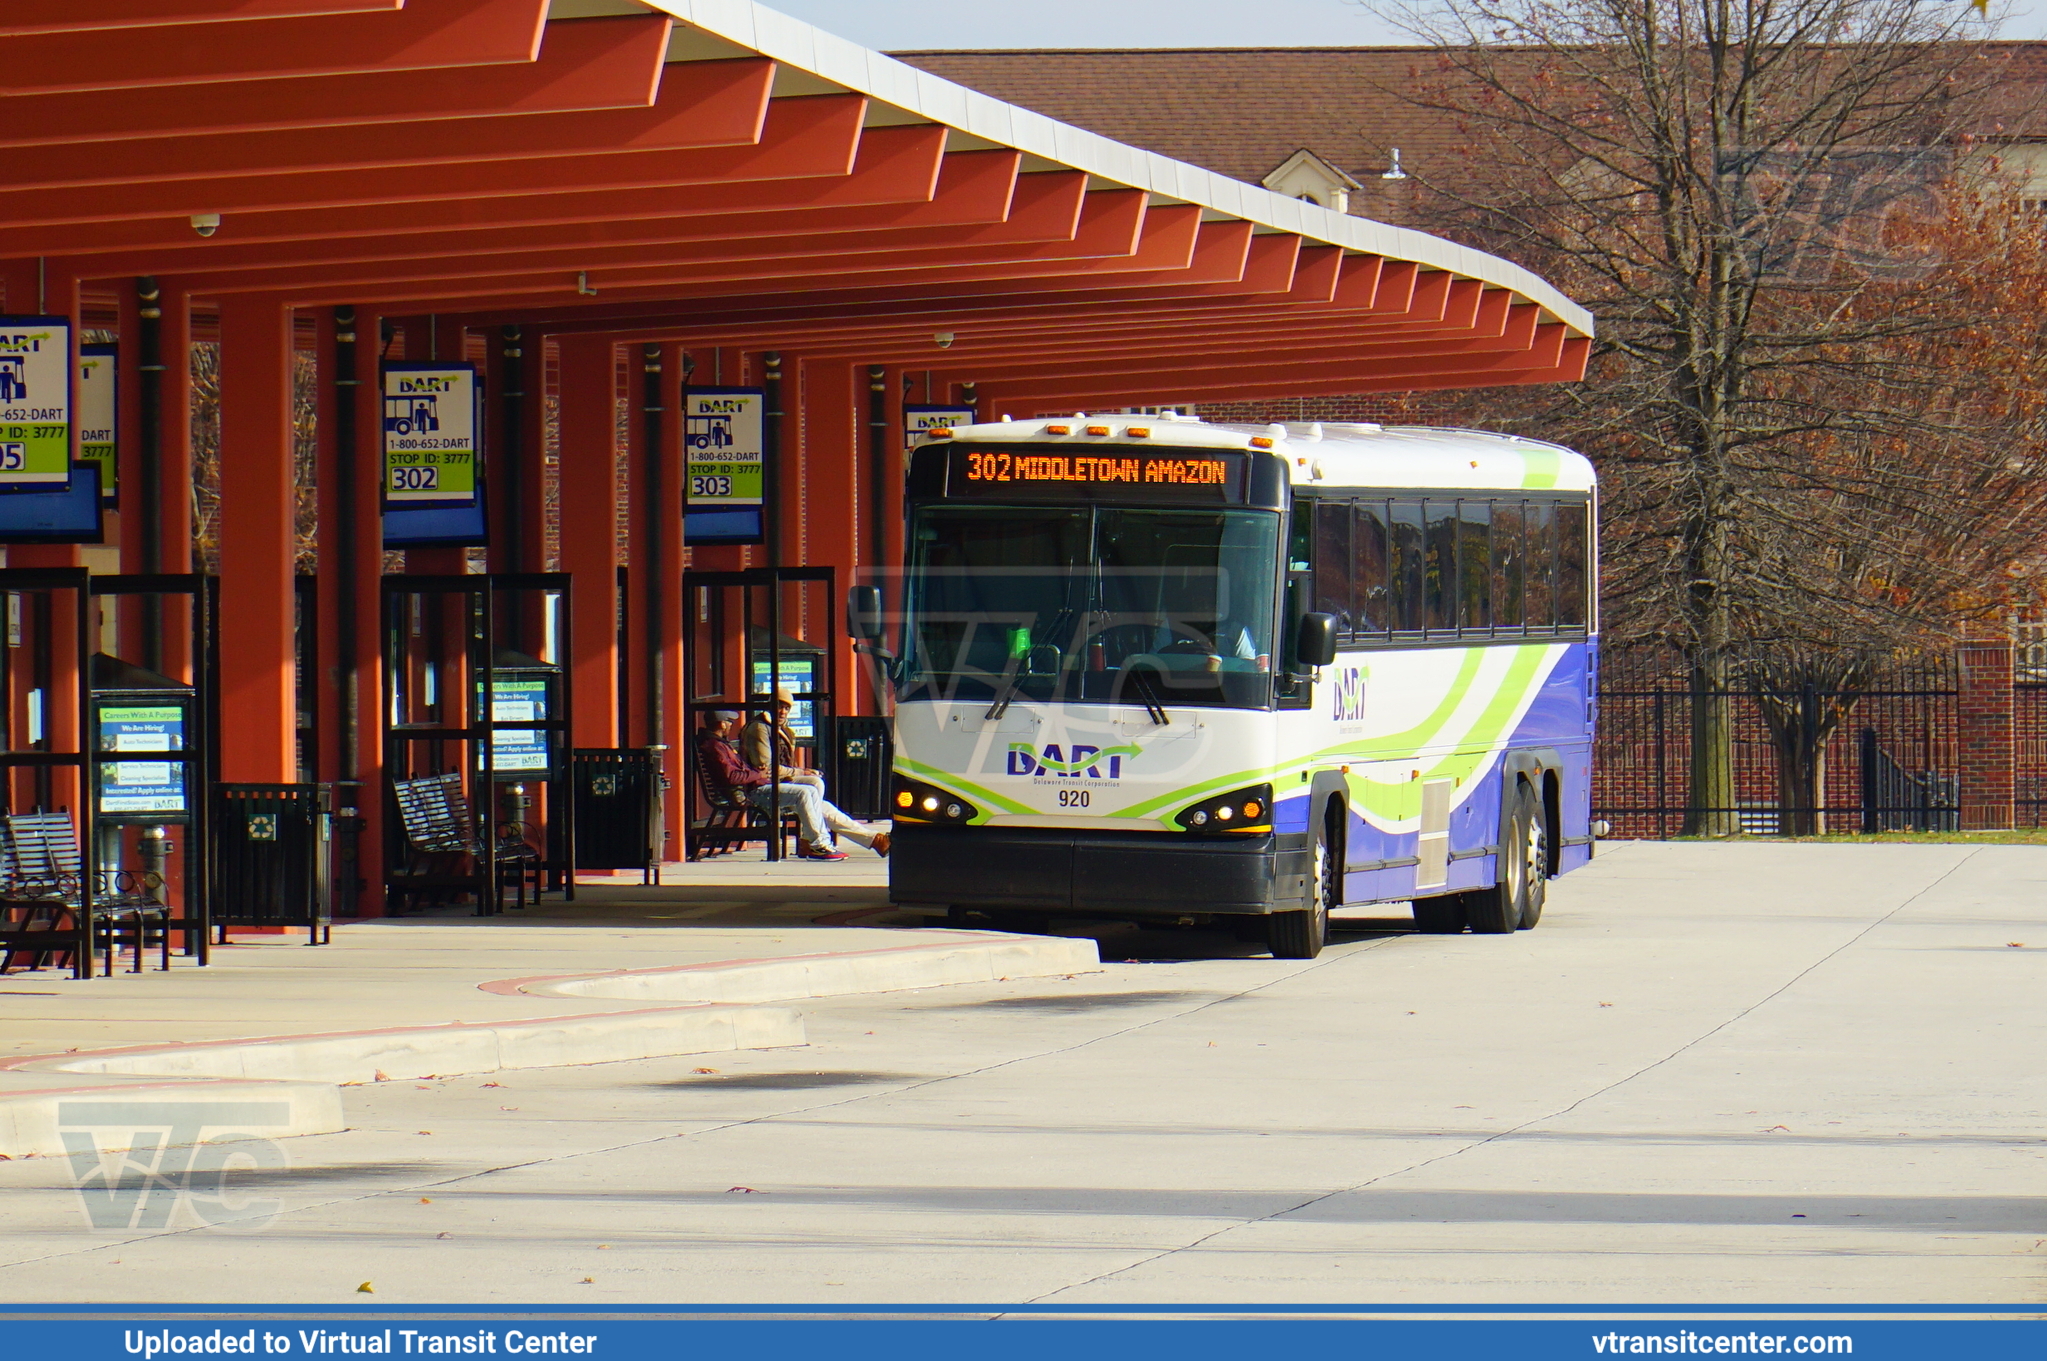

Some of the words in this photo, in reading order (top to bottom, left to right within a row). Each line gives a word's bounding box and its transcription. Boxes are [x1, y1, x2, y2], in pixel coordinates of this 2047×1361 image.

[400, 376, 456, 393] DART
[700, 399, 747, 413] DART
[918, 415, 959, 428] DART
[9, 428, 27, 438] ID:
[33, 426, 65, 438] 3777
[391, 438, 470, 449] 1-800-652-DART
[0, 444, 21, 469] 5
[83, 446, 112, 457] 3777
[390, 454, 420, 464] STOP
[424, 454, 440, 464] ID:
[444, 453, 470, 464] 3777
[691, 452, 759, 462] 1-800-652-DART
[690, 465, 716, 474] STOP
[720, 465, 734, 474] ID:
[738, 464, 761, 474] 3777
[968, 453, 1010, 482] 302
[1015, 456, 1139, 483] MIDDLETOWN
[1145, 459, 1225, 484] AMAZON
[393, 468, 436, 489] 302
[693, 477, 730, 495] 303
[1333, 666, 1369, 721] DART
[1007, 742, 1130, 779] DART
[1033, 777, 1061, 786] Delaware
[1062, 778, 1084, 786] Transit
[1084, 779, 1120, 788] Corporation
[1058, 789, 1090, 808] 920
